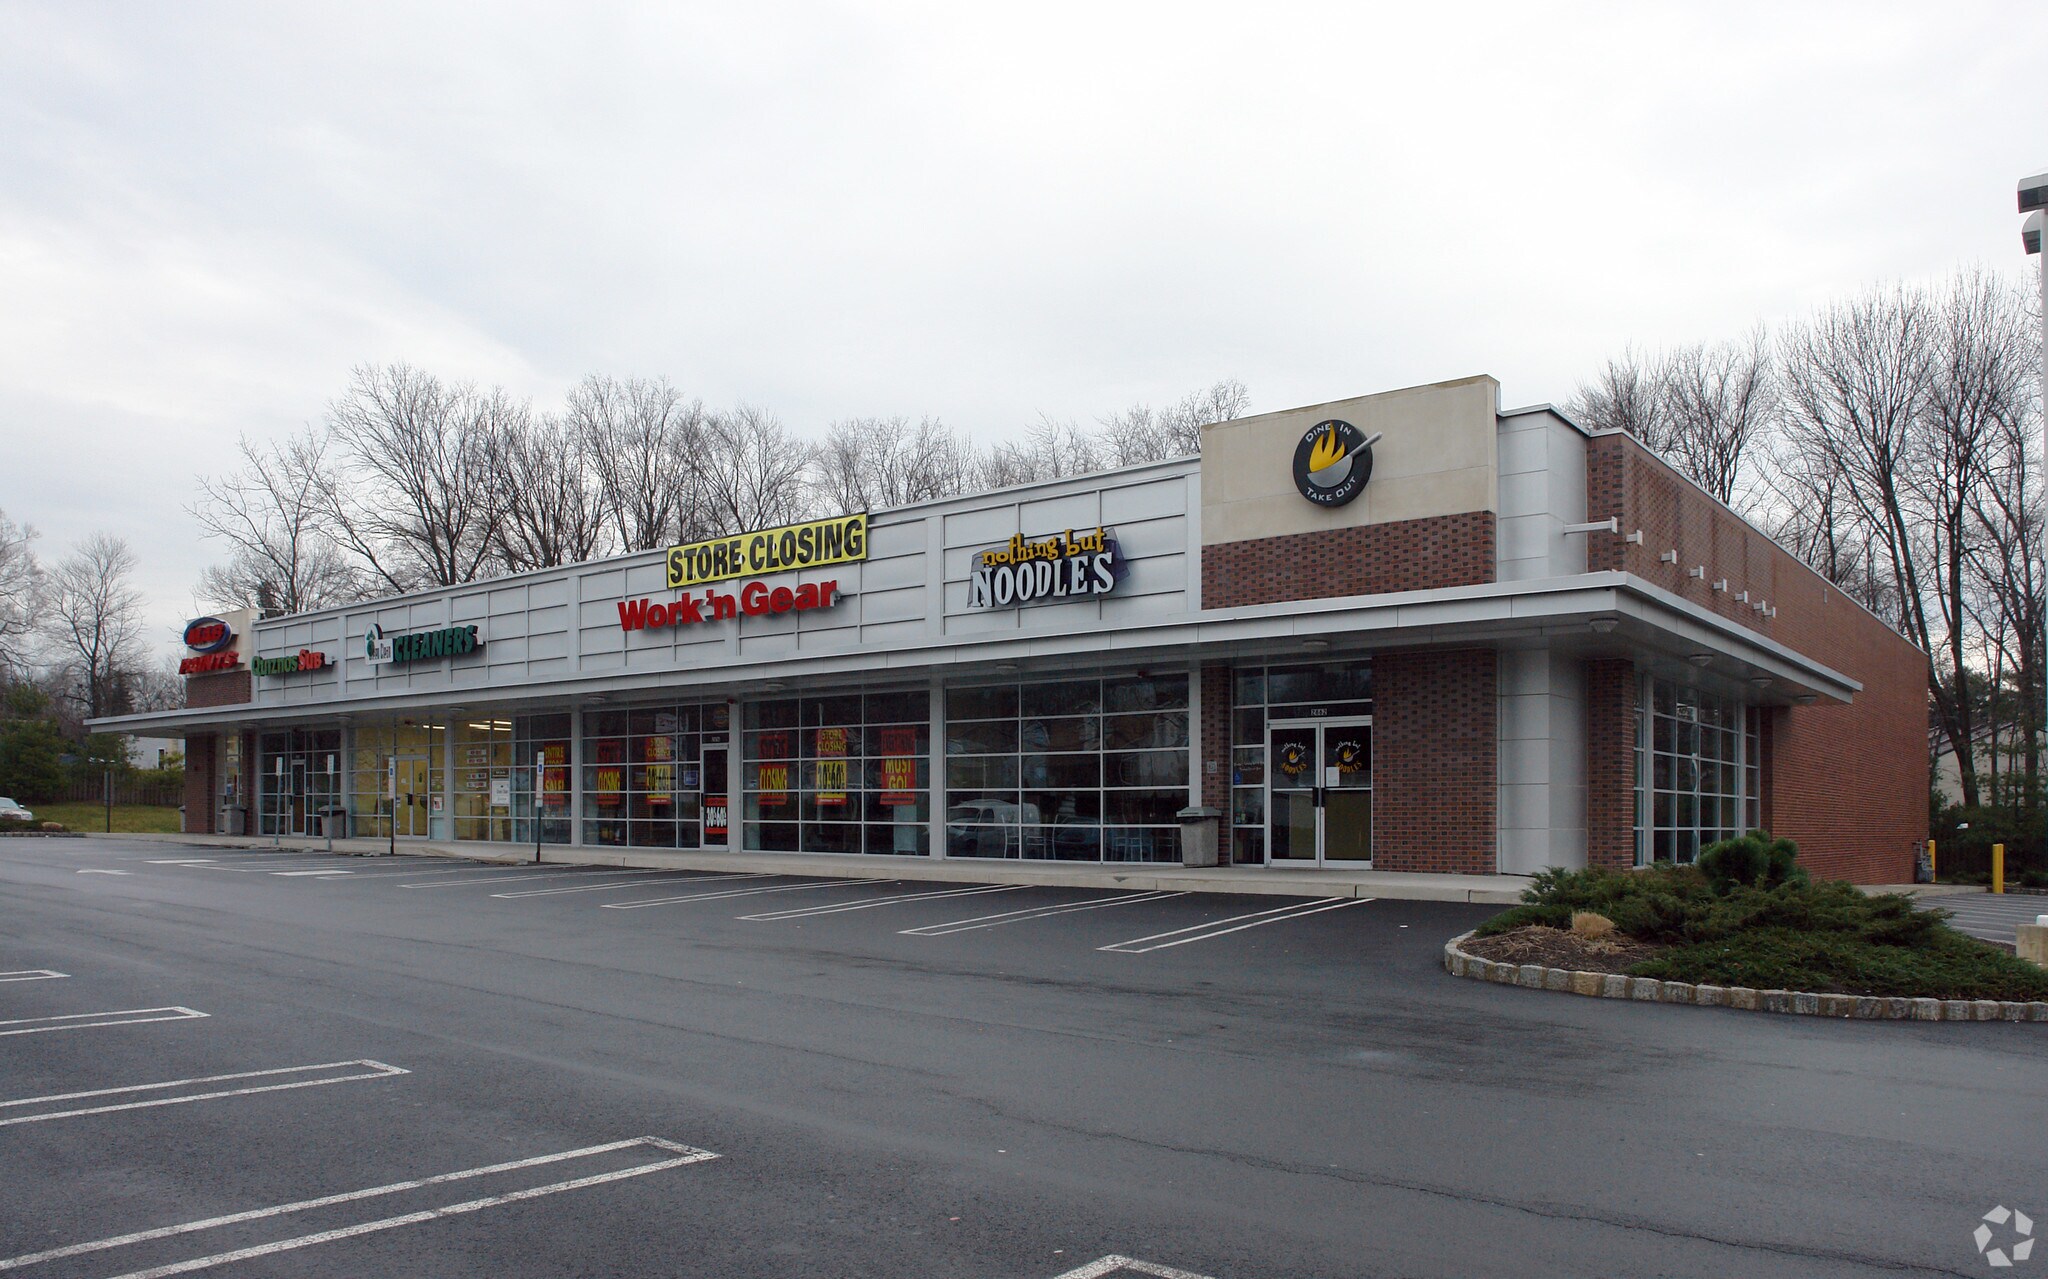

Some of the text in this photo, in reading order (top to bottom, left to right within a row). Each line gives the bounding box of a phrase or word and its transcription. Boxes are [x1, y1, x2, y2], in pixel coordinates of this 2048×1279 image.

[1305, 423, 1352, 443] DINE IN
[1306, 475, 1356, 502] TAKE OUT
[669, 518, 863, 584] STORE CLOSING
[981, 526, 1106, 566] nothing but
[970, 551, 1114, 608] NOODLES
[740, 579, 838, 617] Gear
[394, 624, 479, 663] CLEANERS
[179, 650, 240, 675] PAINTS
[817, 740, 847, 753] CLOSING
[821, 729, 843, 741] STORE
[545, 746, 564, 759] ENTIRE
[885, 756, 912, 774] MUST
[759, 767, 787, 797] CLOSING
